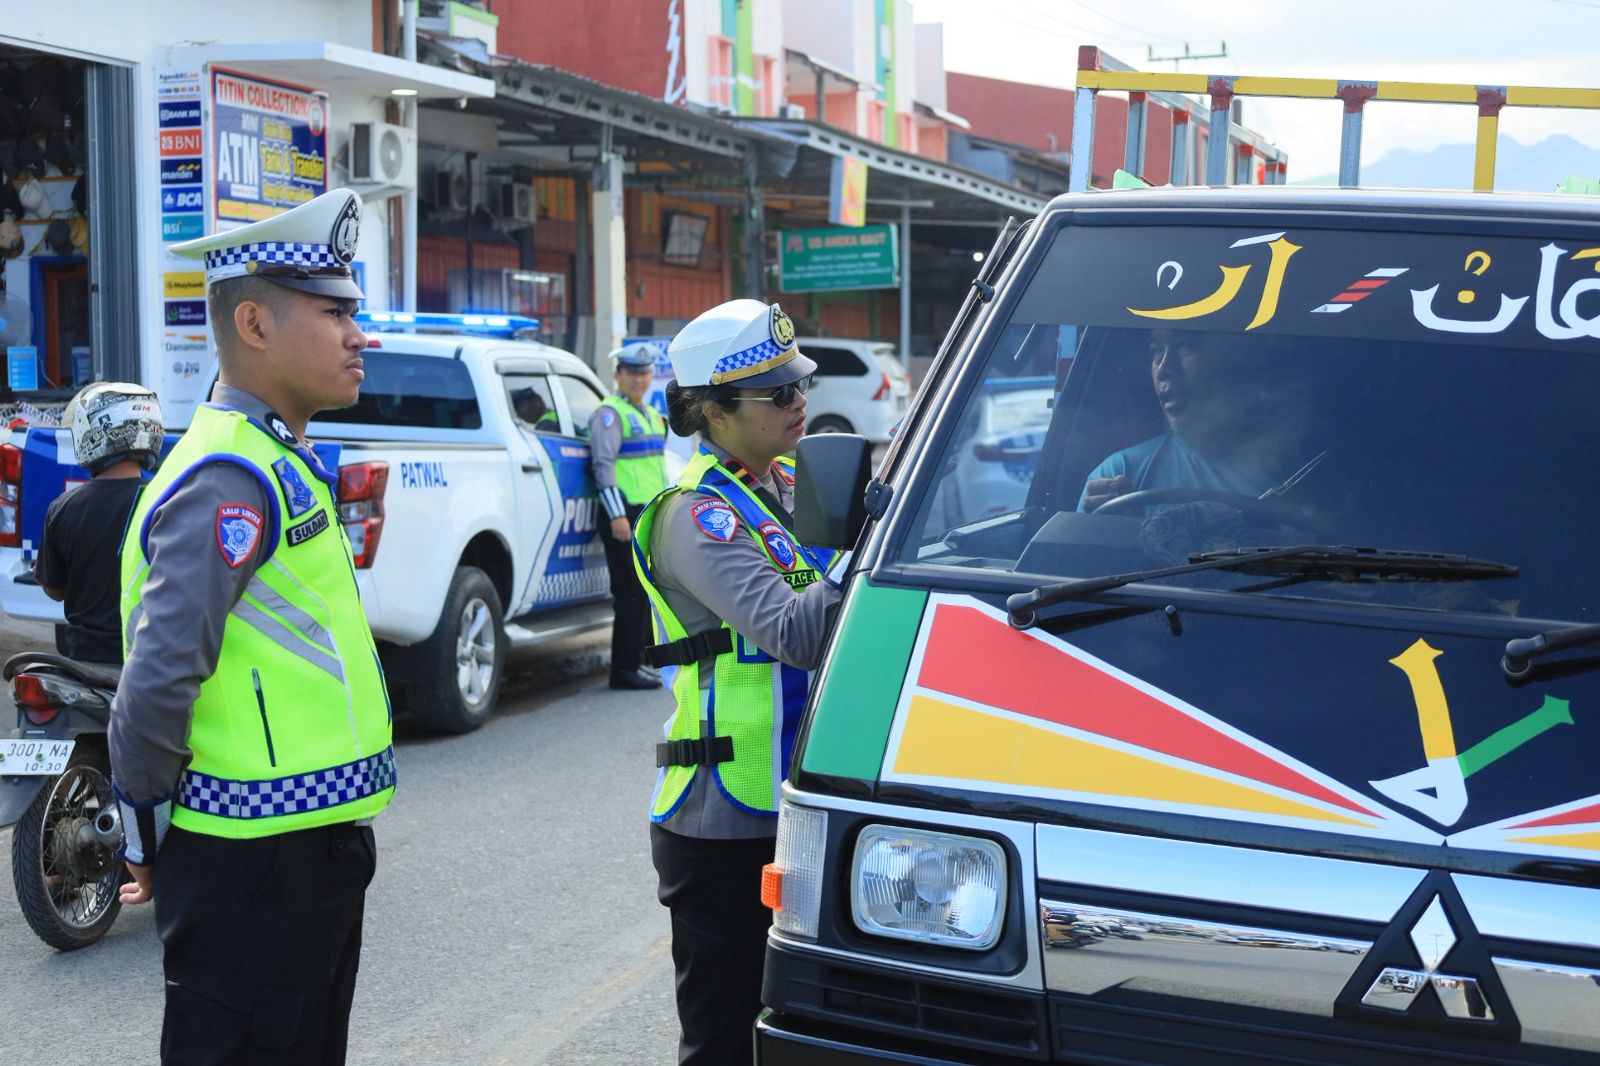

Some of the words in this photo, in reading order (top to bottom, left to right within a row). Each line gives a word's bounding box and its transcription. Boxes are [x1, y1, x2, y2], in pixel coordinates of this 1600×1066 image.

[219, 79, 245, 101] TITIN
[248, 86, 307, 116] COLLECTION
[169, 110, 188, 119] BANK
[175, 134, 200, 149] BNI
[218, 131, 259, 186] ATM
[291, 148, 325, 182] Transfer
[162, 167, 193, 180] mandiri
[176, 193, 202, 207] BCA
[164, 222, 180, 234] BSI
[165, 342, 207, 352] Danamon
[401, 462, 448, 489] PATWAL
[222, 507, 240, 515] LALU
[694, 502, 709, 513] LALU
[563, 497, 598, 534] POLI
[783, 572, 814, 586] RACE
[50, 744, 69, 757] NA
